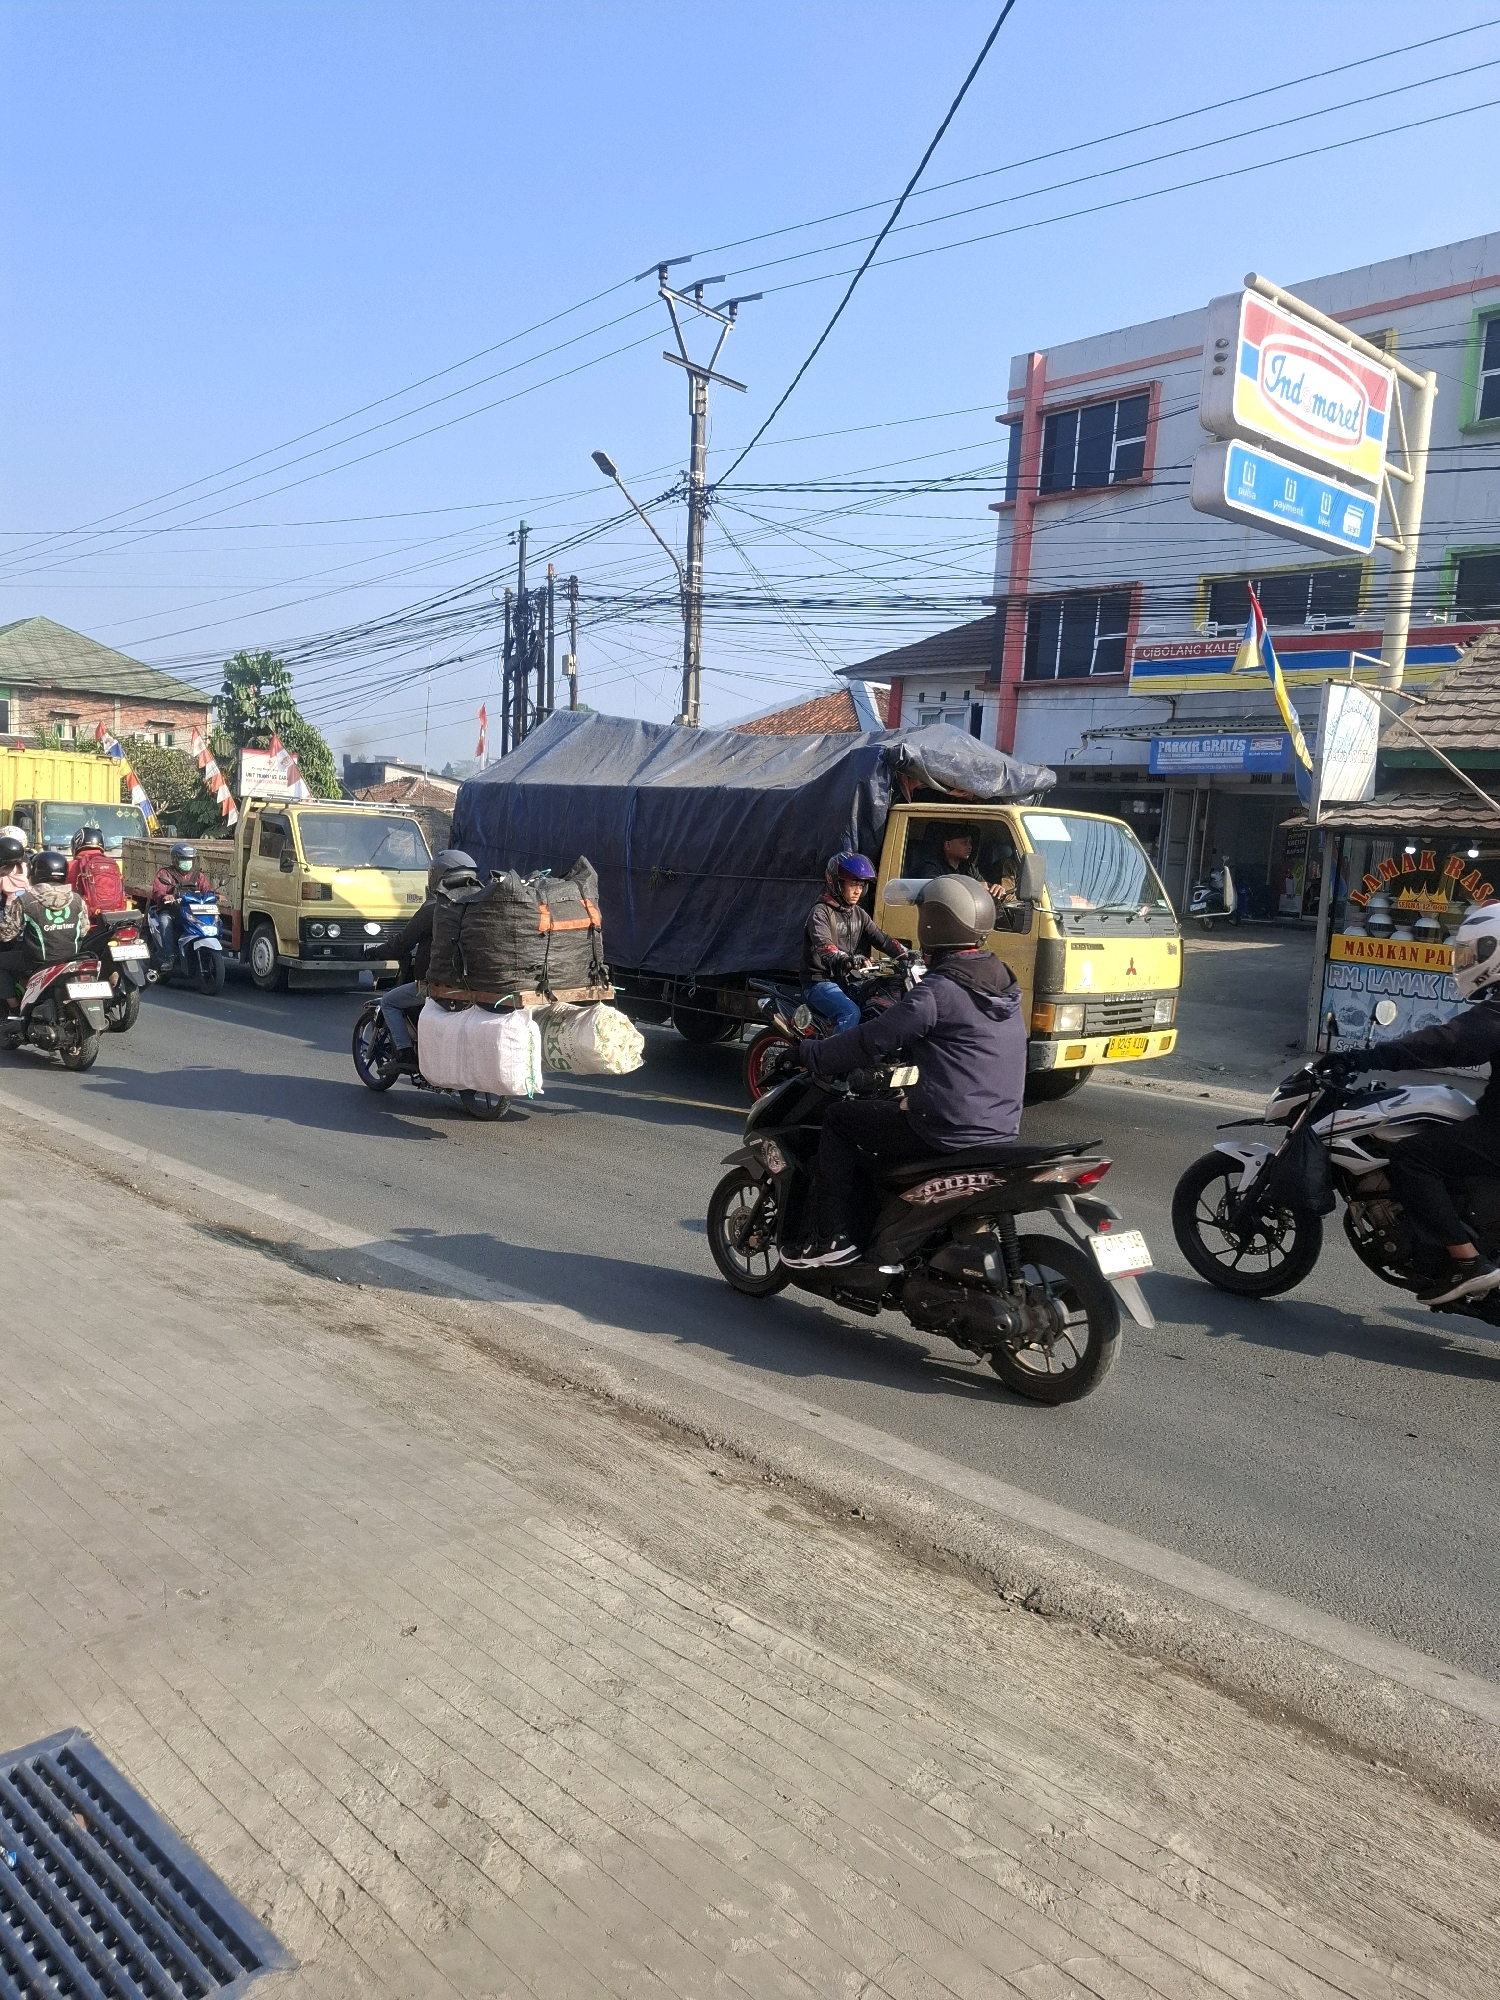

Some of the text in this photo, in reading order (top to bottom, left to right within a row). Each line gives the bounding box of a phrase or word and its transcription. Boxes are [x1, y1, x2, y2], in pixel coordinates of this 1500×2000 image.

[1238, 486, 1256, 500] pulsa
[1273, 499, 1304, 517] payment
[1142, 644, 1202, 659] CIBOLANG
[1158, 740, 1200, 753] PARKIR
[1202, 738, 1247, 752] GRATIS
[1350, 850, 1436, 906] LAMAK
[1344, 940, 1420, 962] MASAKAN
[1327, 964, 1363, 991] RM.
[1366, 968, 1440, 1000] LAMAK
[924, 1174, 989, 1196] STREET
